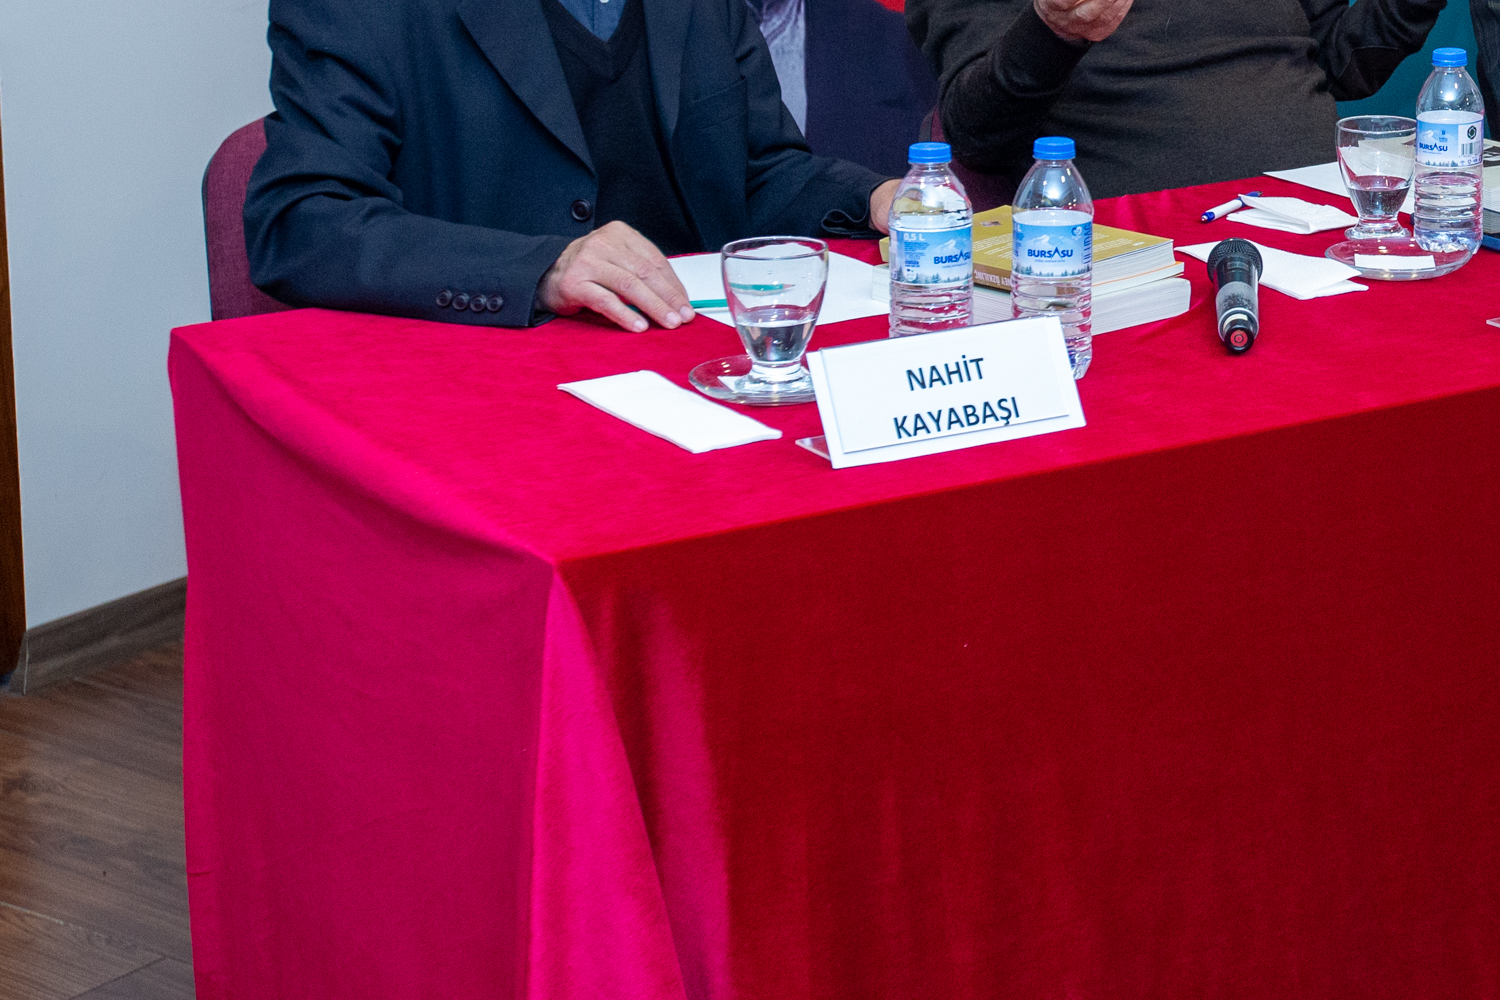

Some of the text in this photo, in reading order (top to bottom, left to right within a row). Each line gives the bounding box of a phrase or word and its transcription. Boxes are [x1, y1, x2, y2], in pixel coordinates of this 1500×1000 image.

[903, 232, 925, 242] 0,5 L
[1027, 246, 1074, 259] BURSASU
[906, 354, 984, 391] NAHİT
[893, 396, 1020, 439] KAYABAŞI
